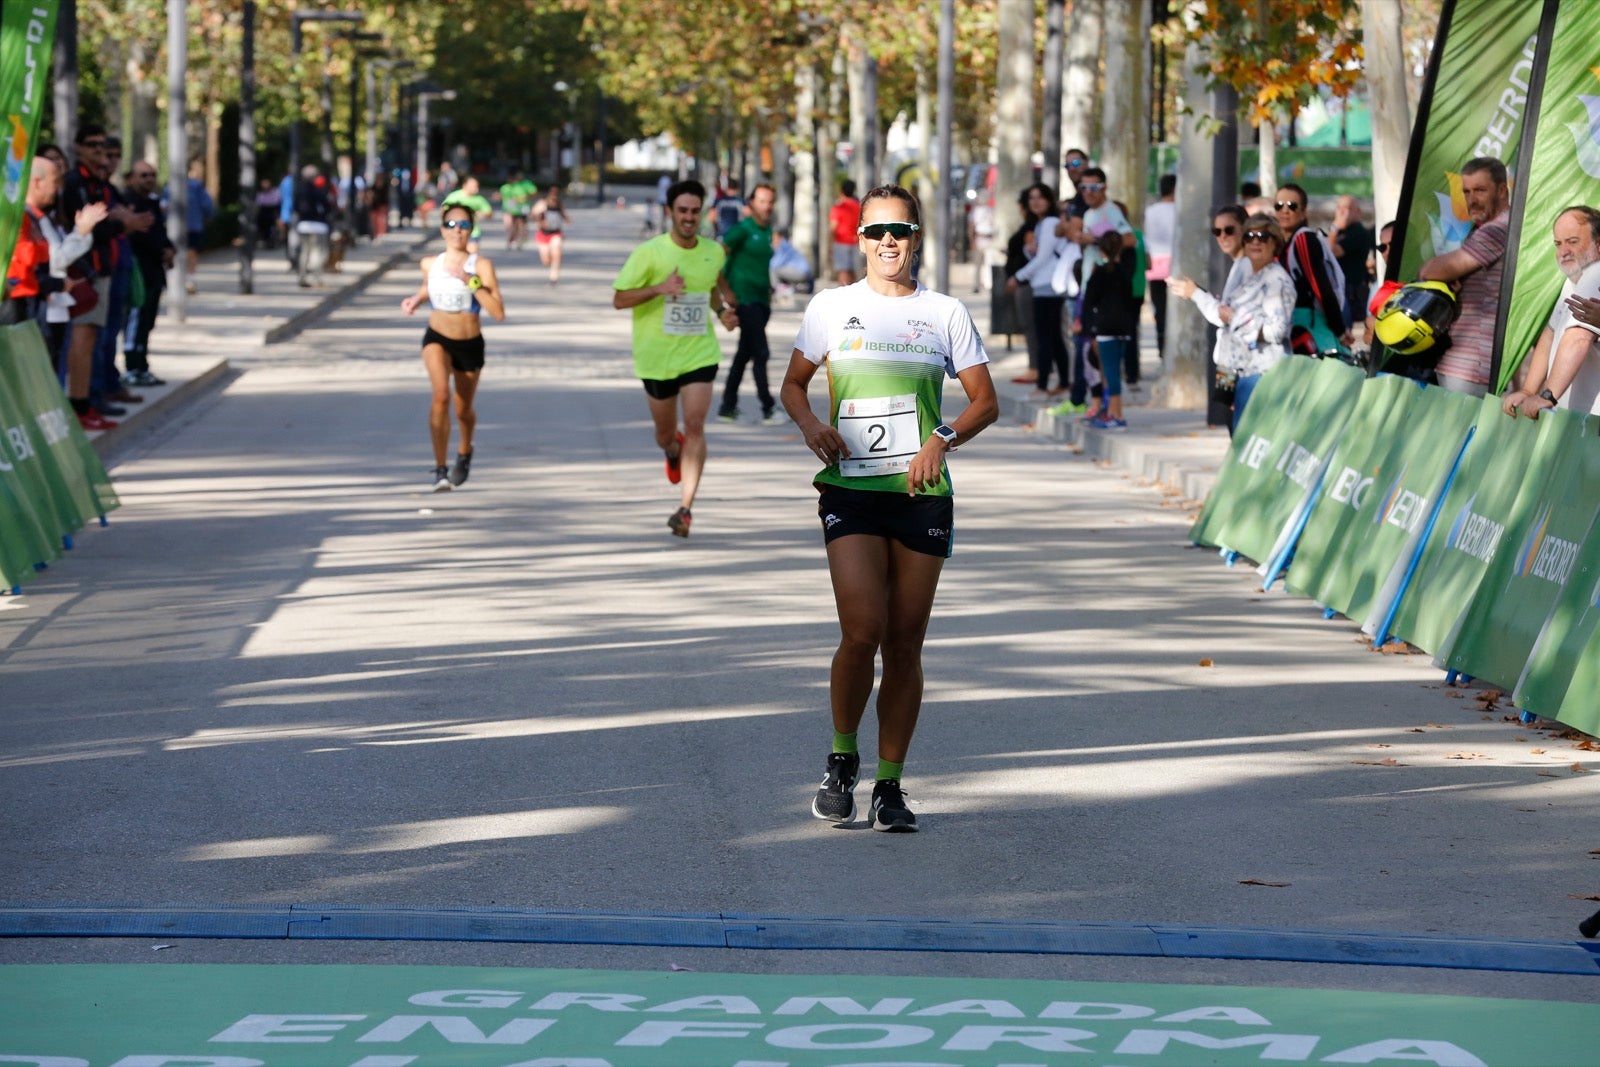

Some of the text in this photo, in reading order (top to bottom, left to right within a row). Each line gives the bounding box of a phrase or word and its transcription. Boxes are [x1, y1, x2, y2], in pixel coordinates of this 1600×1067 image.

[671, 306, 702, 323] 530
[865, 341, 937, 356] IBERDROLA
[868, 424, 887, 453] 2
[407, 989, 1272, 1026] GRANADA
[208, 1014, 1488, 1067] EN FORMA
